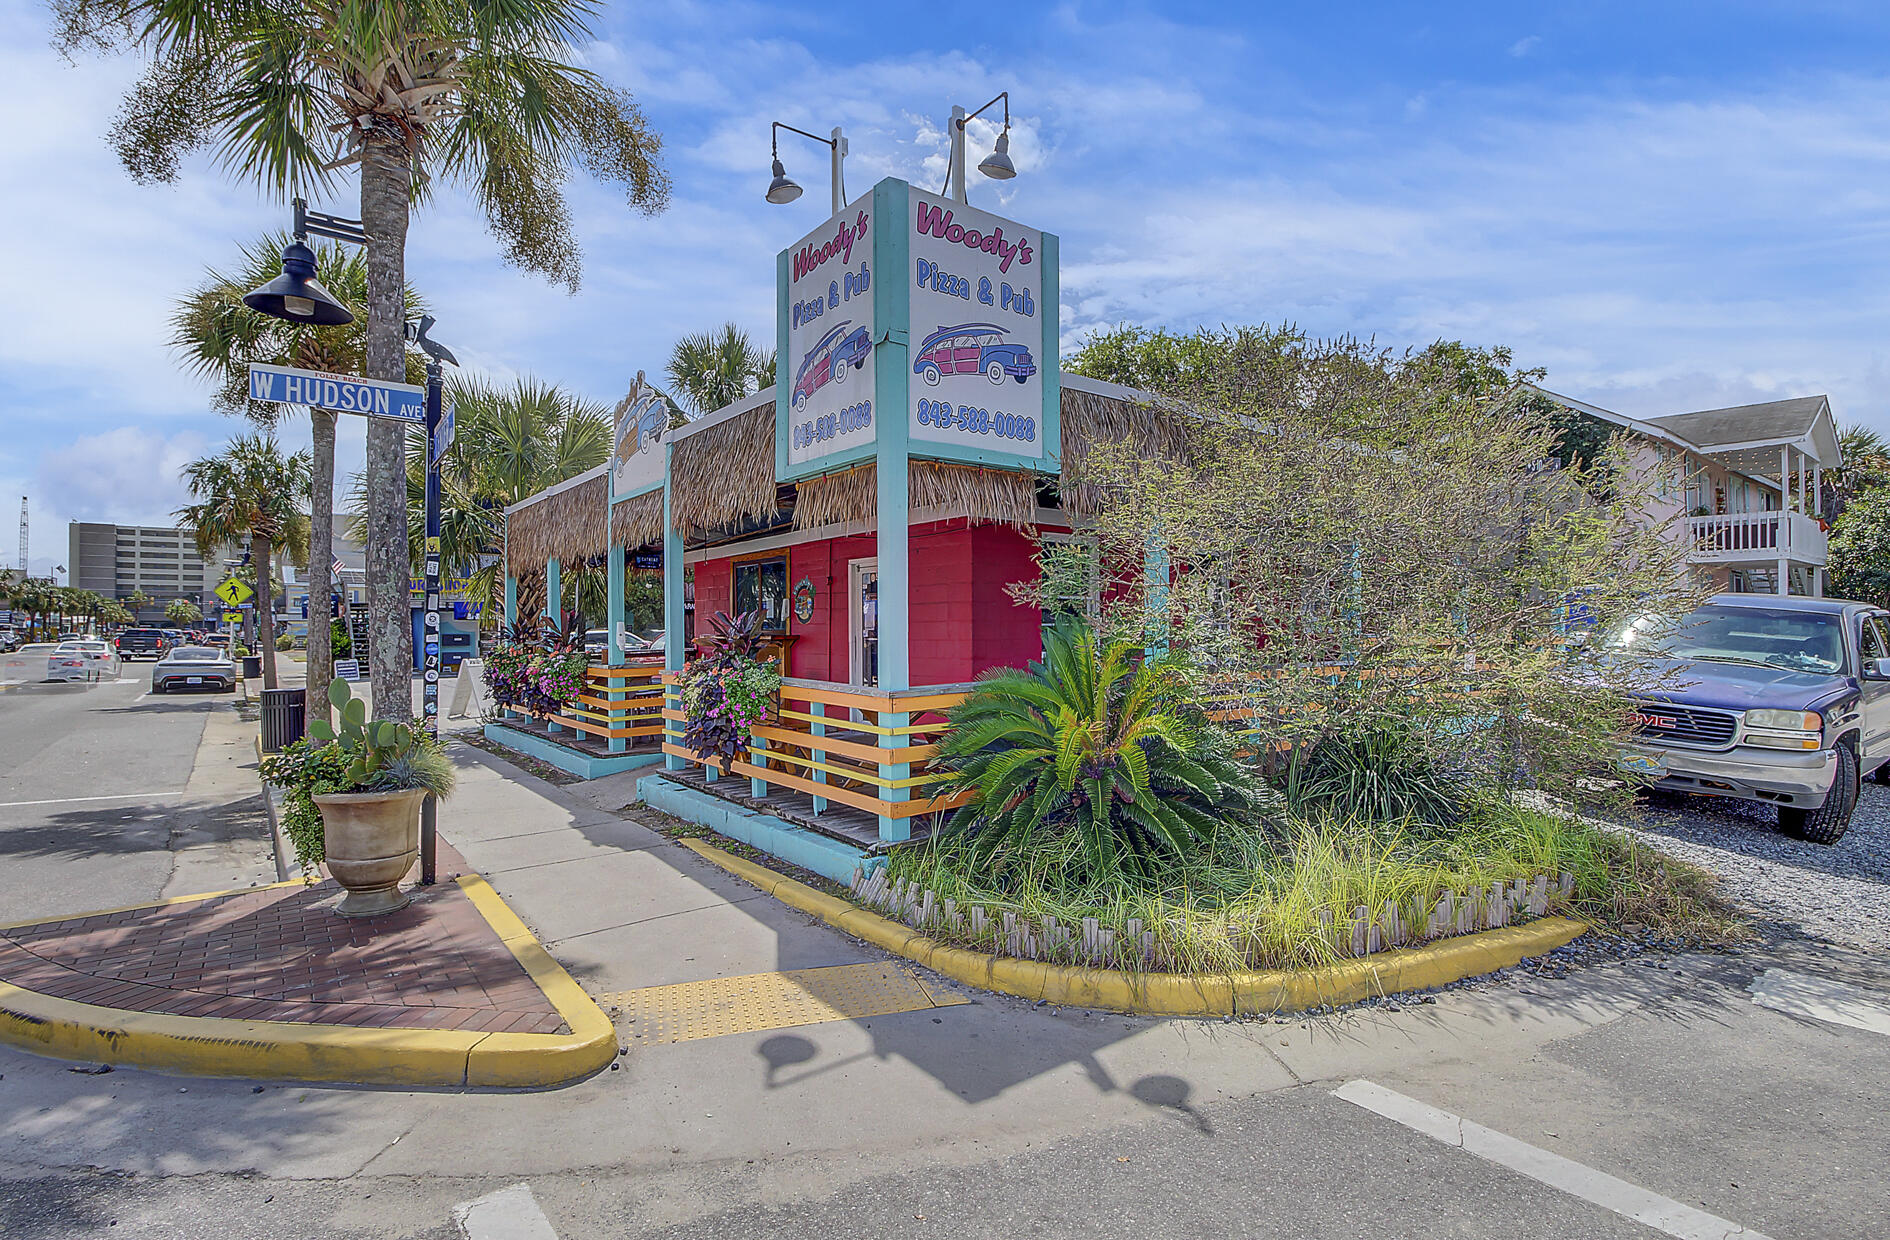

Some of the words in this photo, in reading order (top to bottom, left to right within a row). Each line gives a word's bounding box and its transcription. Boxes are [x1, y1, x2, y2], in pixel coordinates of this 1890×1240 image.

[793, 210, 869, 283] Woody's
[916, 201, 1034, 274] Woody's
[792, 295, 824, 330] Pizza
[828, 280, 840, 310] &
[843, 262, 870, 301] Pub
[916, 257, 970, 300] Pizza
[976, 276, 995, 307] &
[1000, 281, 1035, 317] Pub
[252, 371, 274, 399] W
[285, 376, 390, 414] HUDSON
[399, 403, 421, 418] AVE
[314, 372, 340, 381] FOLLY
[342, 376, 368, 385] BEACH
[793, 400, 872, 450] 843-588-0088
[917, 398, 1036, 442] 843-588-0088
